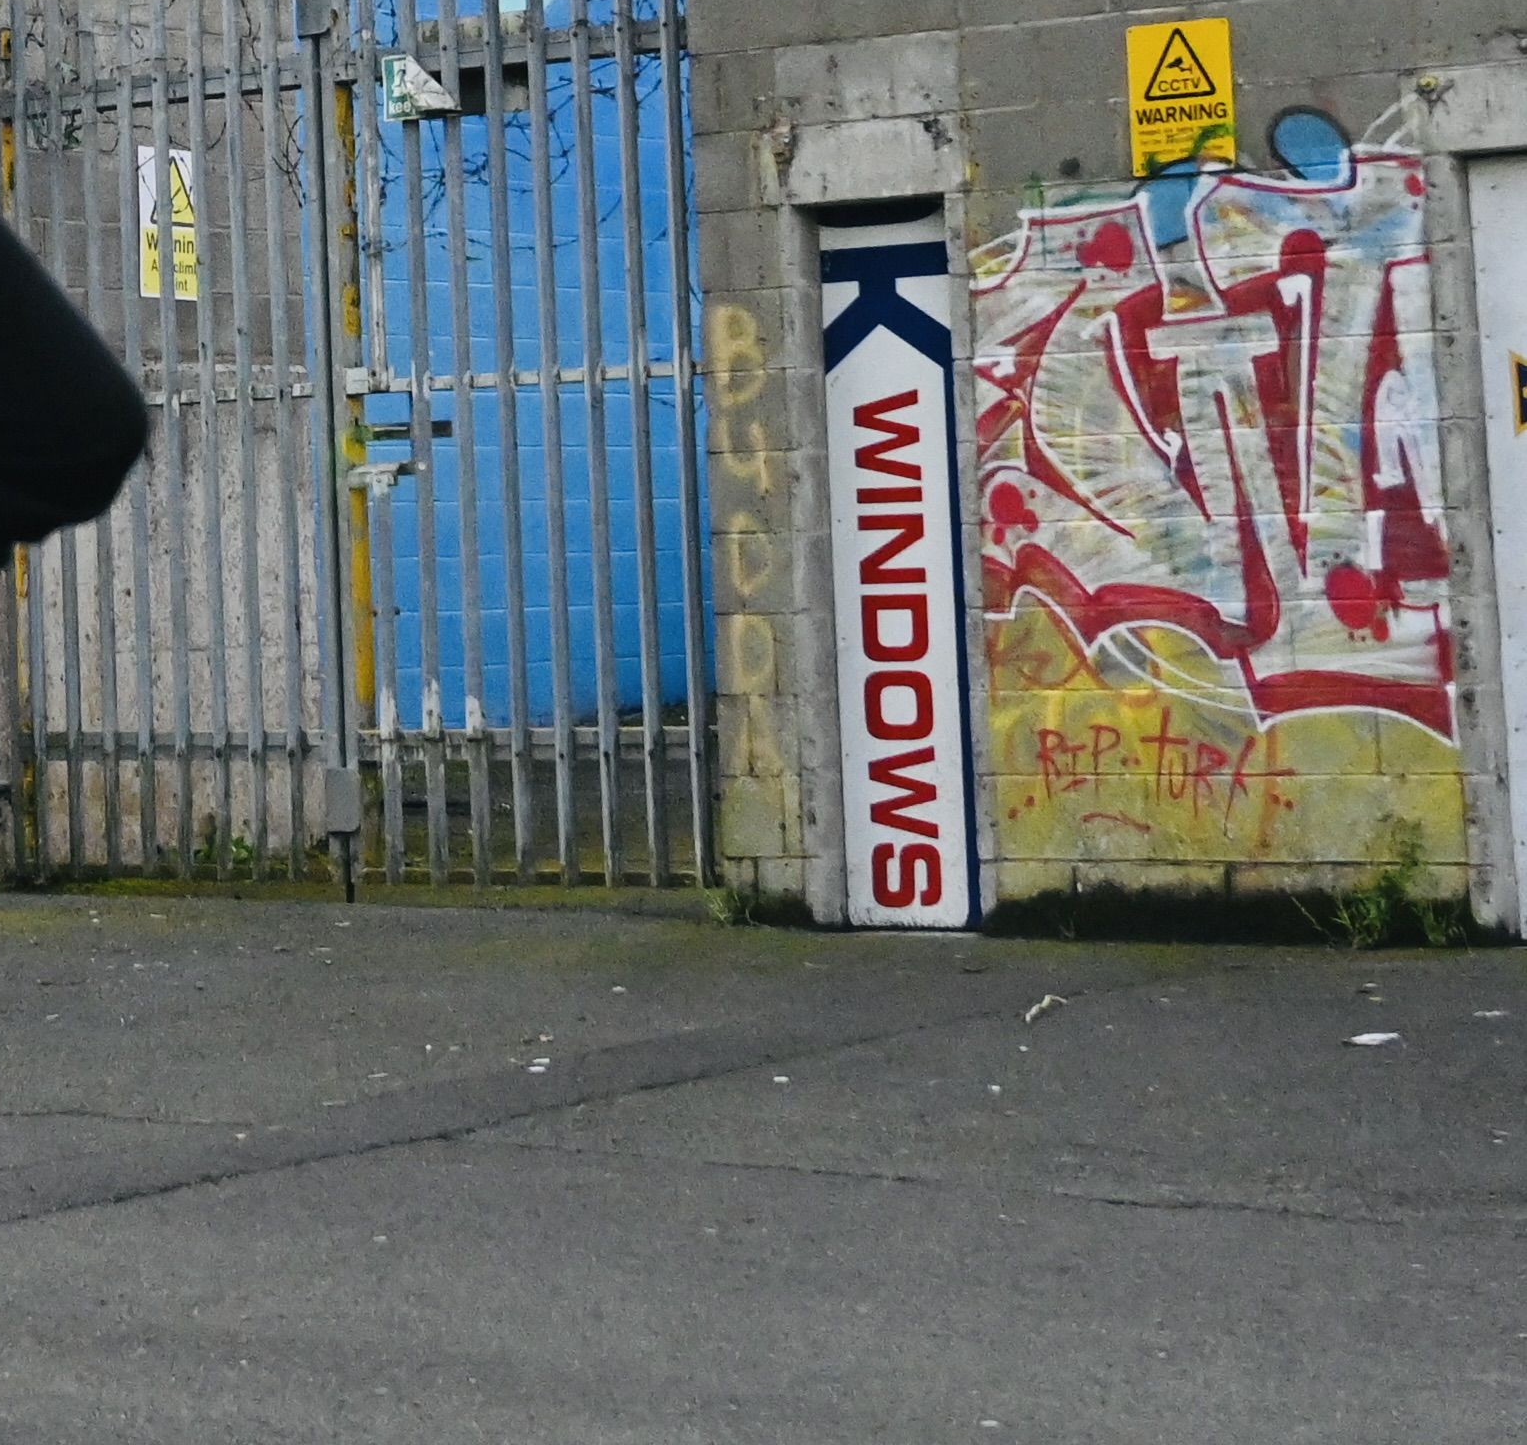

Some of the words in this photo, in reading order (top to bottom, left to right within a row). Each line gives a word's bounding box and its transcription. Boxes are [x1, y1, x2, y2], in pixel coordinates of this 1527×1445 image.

[1157, 77, 1201, 93] CCTV
[388, 100, 416, 115] kee
[1135, 102, 1228, 126] WARNING
[146, 231, 195, 254] Wnin
[852, 389, 943, 908] WINDOWS
